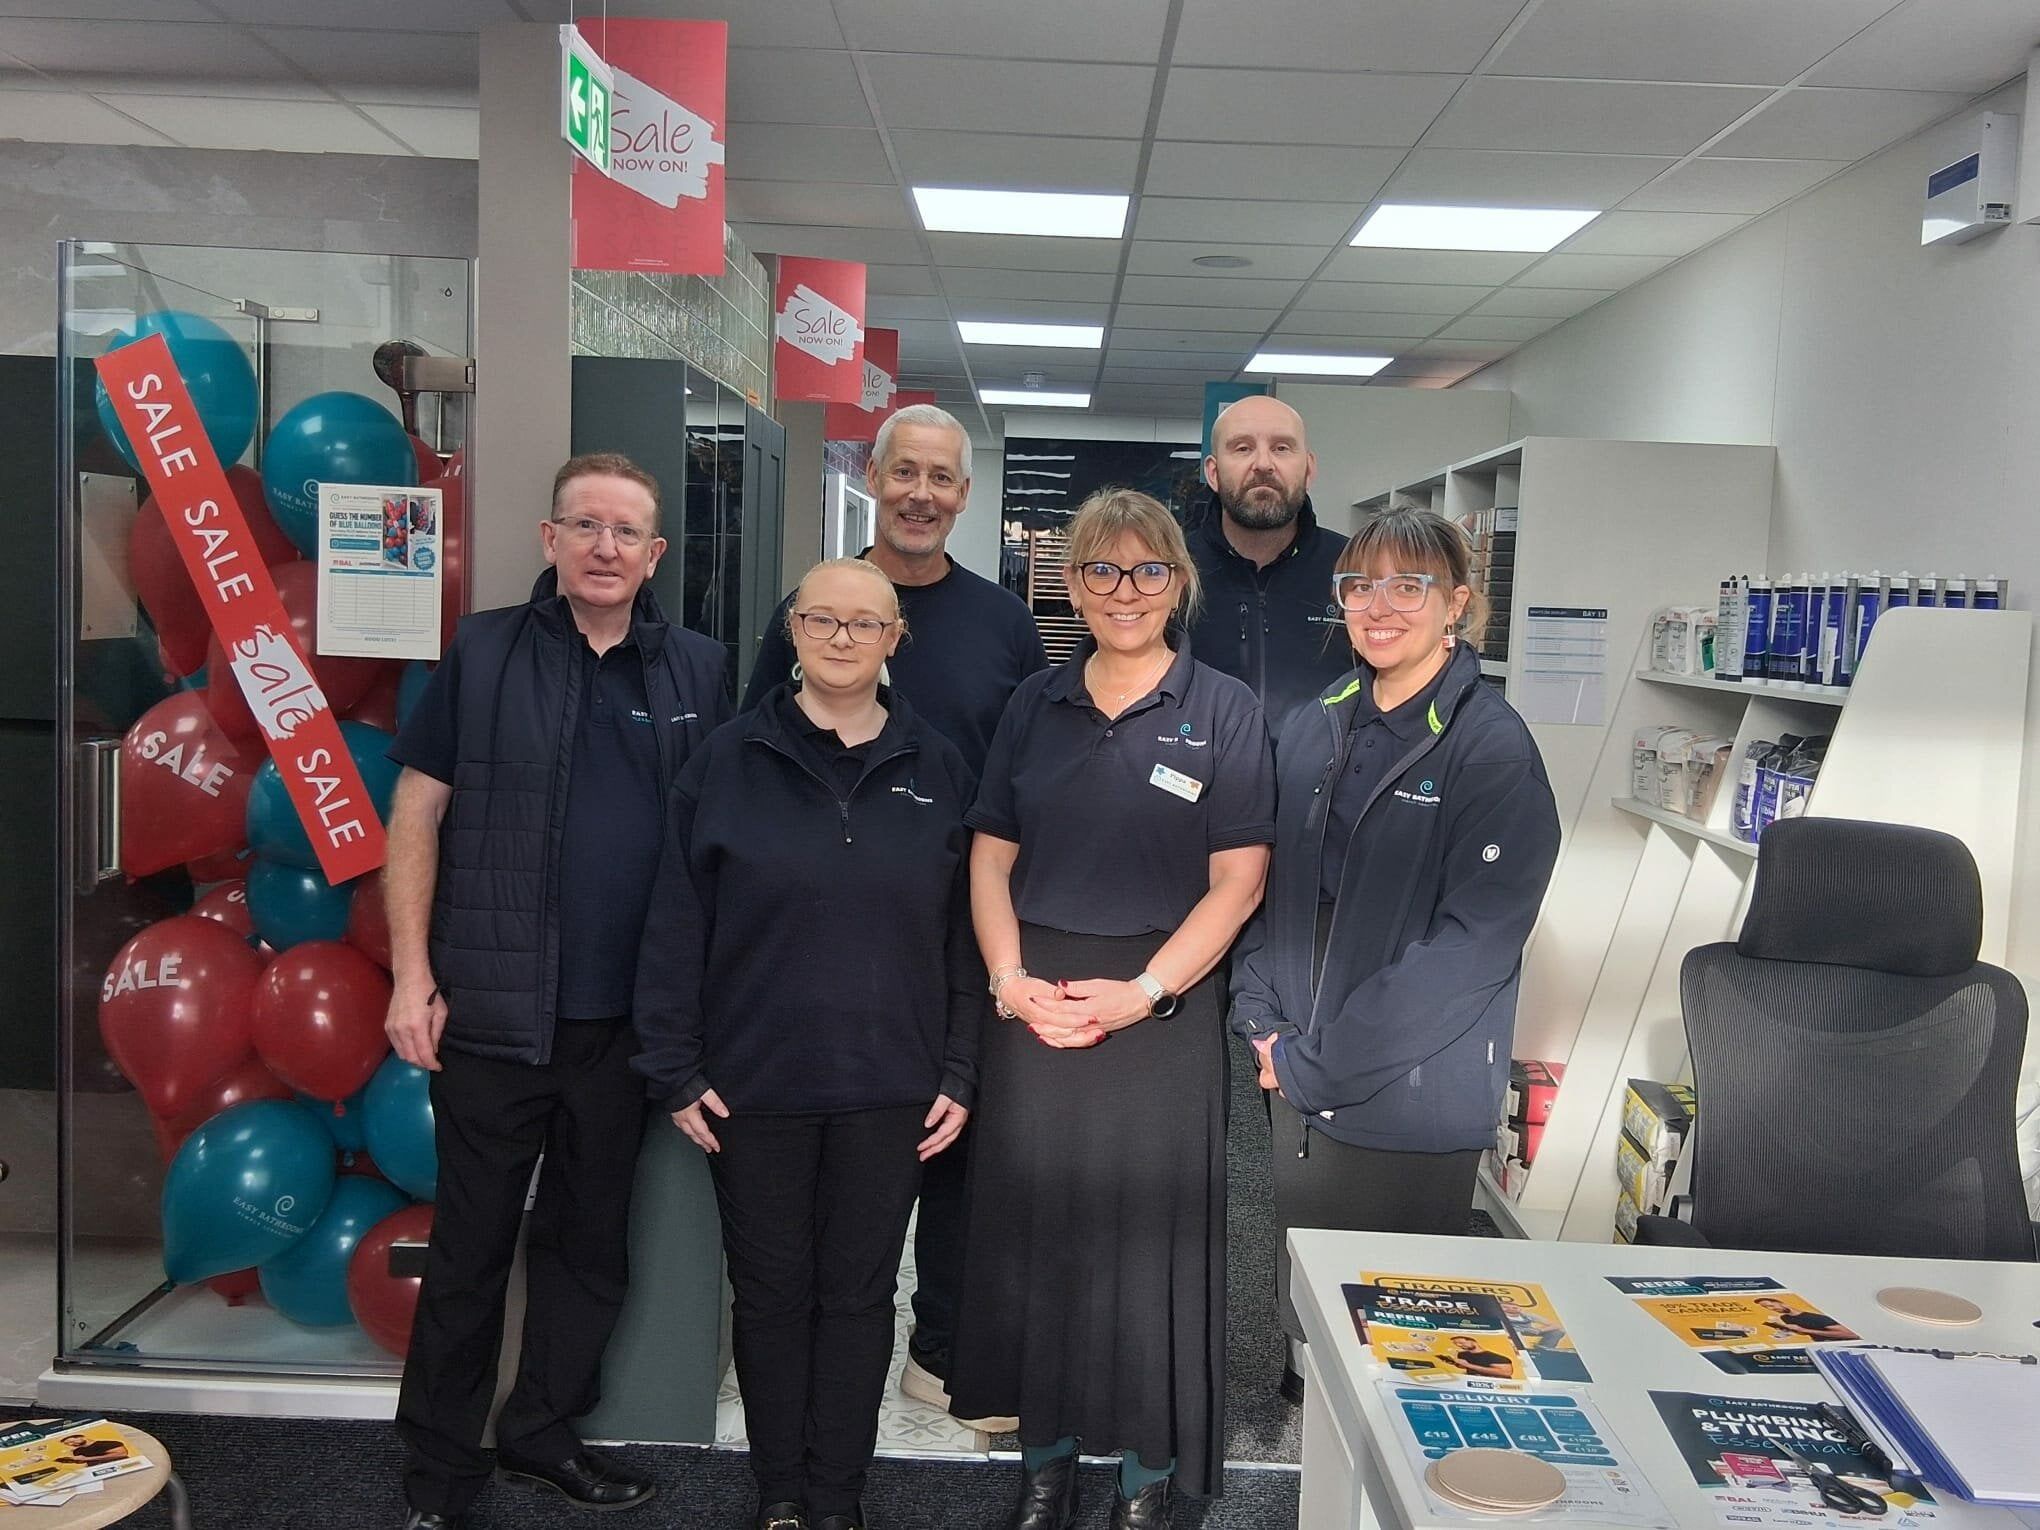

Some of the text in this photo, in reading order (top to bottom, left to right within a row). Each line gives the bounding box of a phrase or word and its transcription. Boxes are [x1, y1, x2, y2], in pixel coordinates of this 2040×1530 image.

[611, 109, 694, 154] Sale
[613, 158, 688, 173] NOW ON!
[794, 308, 847, 335] Sale
[798, 336, 843, 346] NOW ON!
[127, 373, 198, 478] SALE
[329, 512, 382, 521] GUESS THE NUMBER
[329, 520, 337, 528] OF
[338, 520, 352, 528] BLUE
[184, 499, 256, 604] SALE
[236, 628, 314, 733] Sale
[142, 731, 234, 798] SALE
[296, 748, 365, 848] SALE
[102, 953, 183, 1004] SALE
[1393, 1280, 1512, 1295] TRADERS
[1631, 1280, 1690, 1289] REFER
[1378, 1294, 1471, 1310] TRADE
[1373, 1311, 1429, 1323] REFER
[1439, 1392, 1532, 1404] DELIVERY
[1423, 1430, 1450, 1438] £15
[1471, 1432, 1499, 1440] £45
